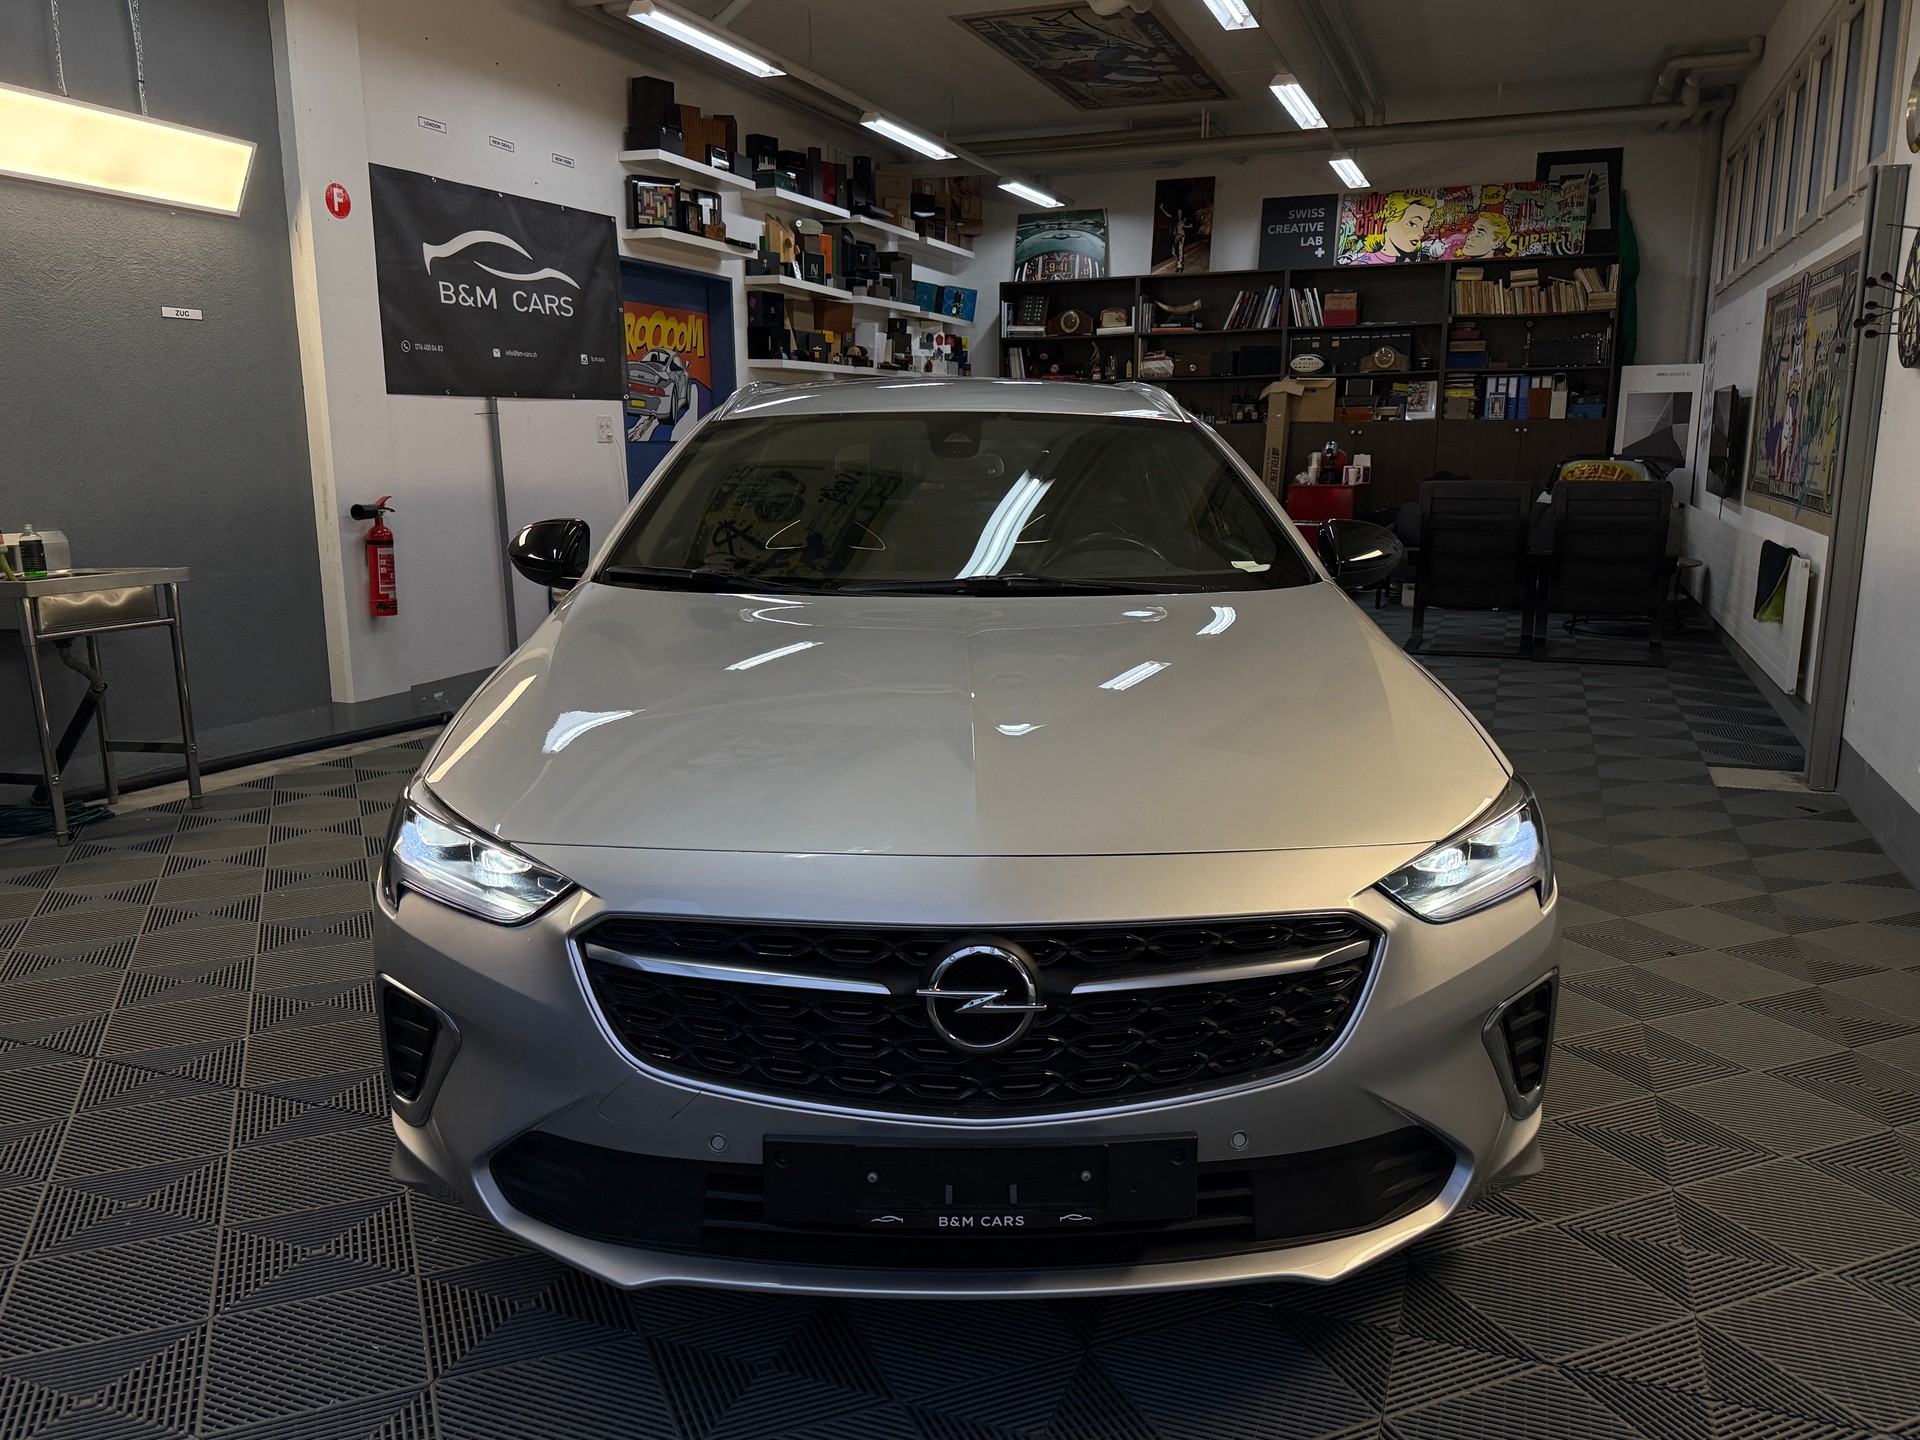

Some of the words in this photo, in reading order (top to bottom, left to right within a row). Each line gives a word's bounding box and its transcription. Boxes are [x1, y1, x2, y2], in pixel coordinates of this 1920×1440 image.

[423, 120, 442, 130] LONDON
[491, 138, 501, 147] NEW
[563, 158, 572, 166] YORK
[333, 187, 344, 212] F
[1288, 207, 1325, 220] SWISS
[1267, 221, 1324, 235] CREATIVE
[1355, 216, 1384, 236] CITY
[1300, 236, 1323, 247] LAB
[438, 280, 498, 310] B&M
[512, 290, 574, 317] CARS
[175, 309, 190, 317] ZUG
[938, 1216, 974, 1227] B&M
[980, 1215, 1025, 1227] CARS
